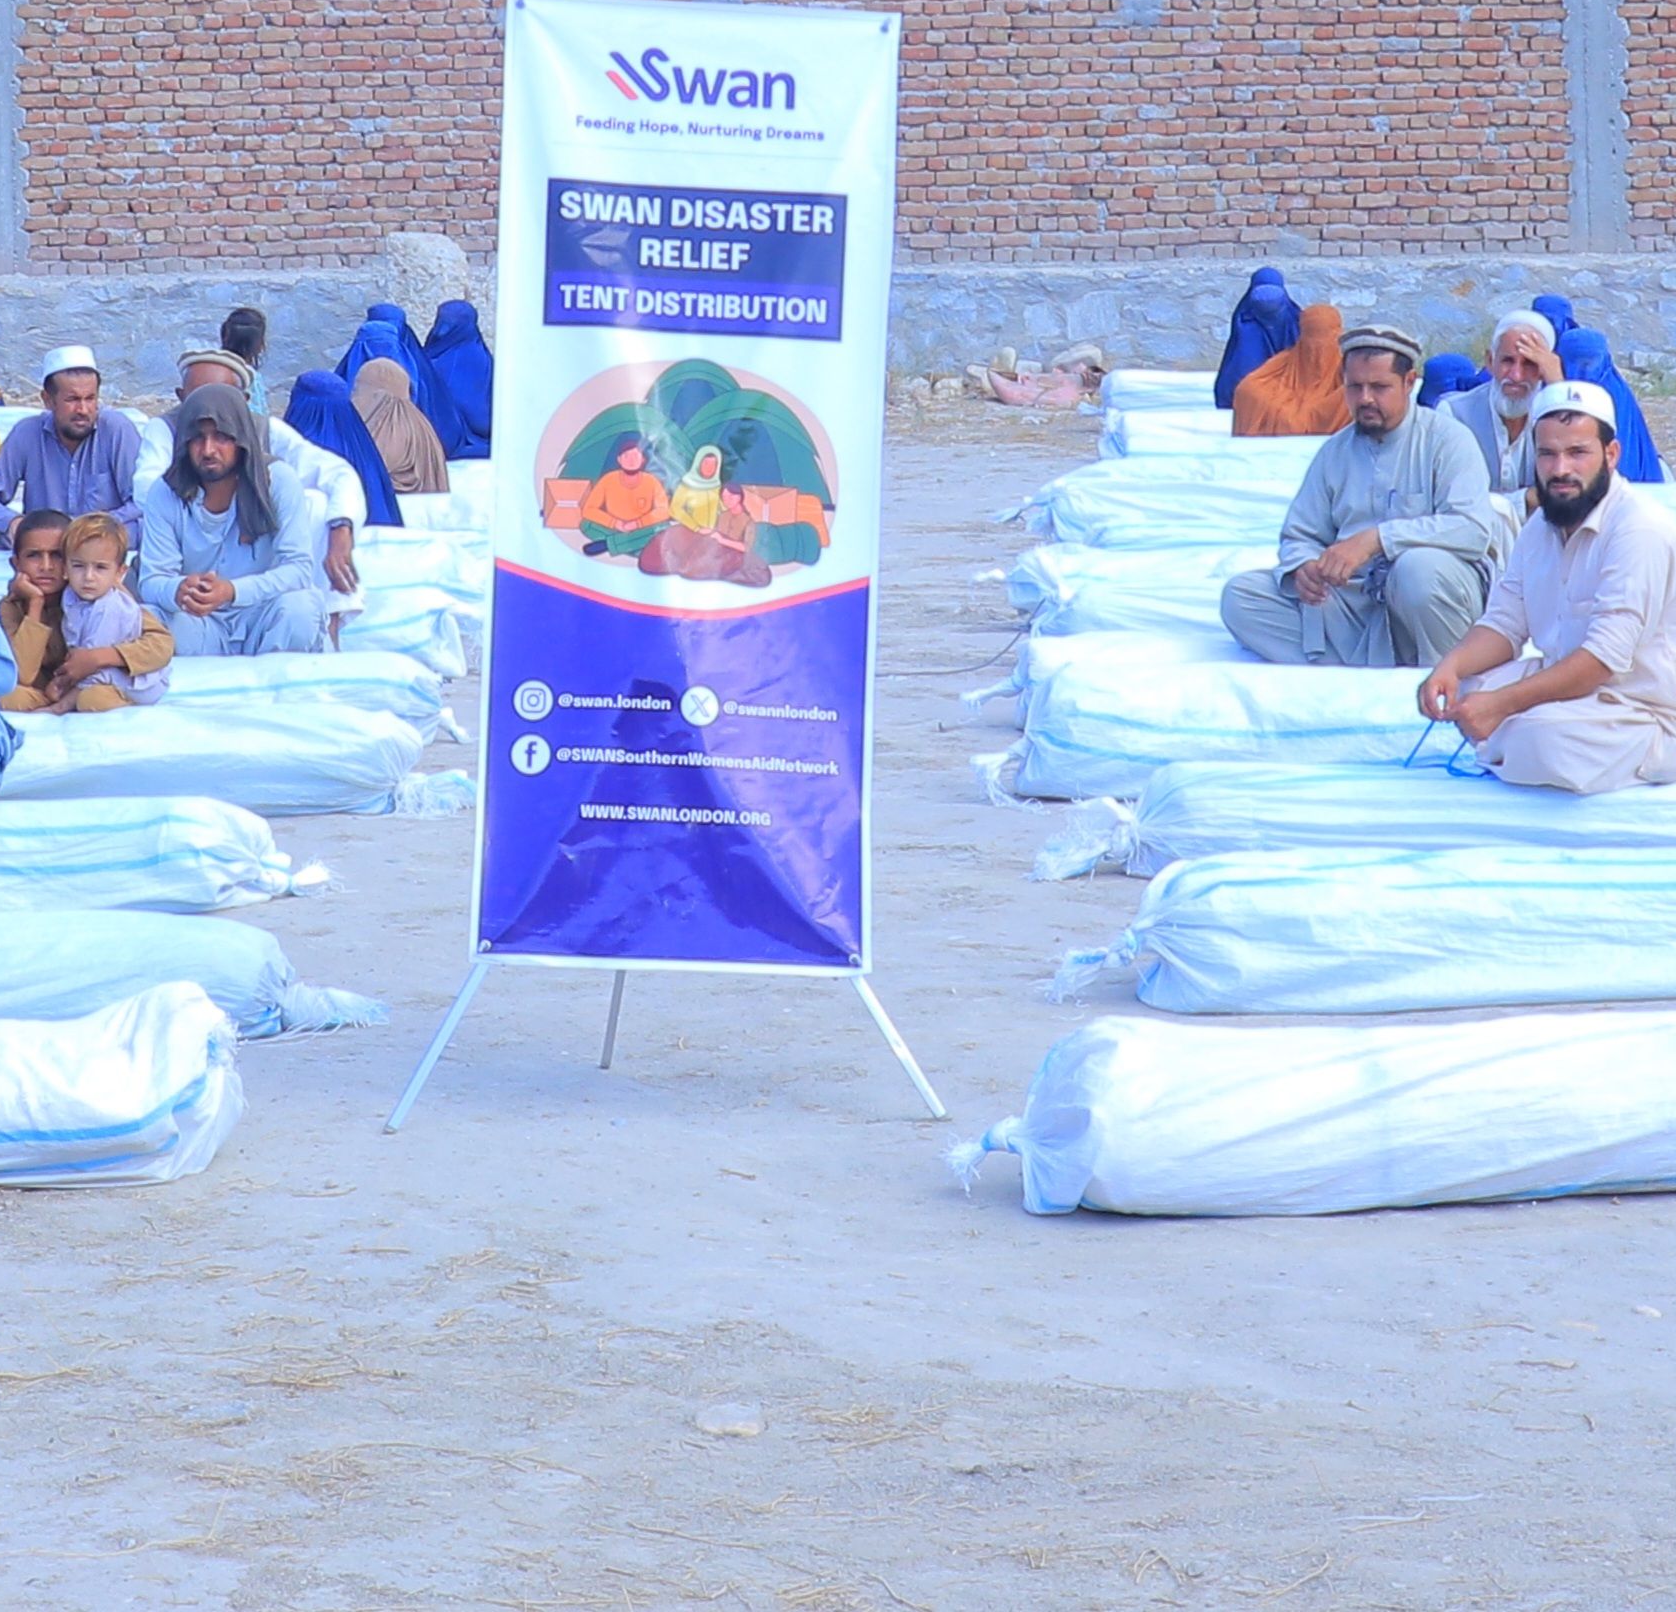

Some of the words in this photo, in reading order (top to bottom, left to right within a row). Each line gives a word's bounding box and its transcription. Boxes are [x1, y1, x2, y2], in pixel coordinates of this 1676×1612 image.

[609, 48, 796, 110] Swan
[576, 115, 636, 134] Feeding
[639, 119, 683, 137] Hope,
[687, 122, 762, 141] Nurturing
[766, 126, 825, 142] Dreams
[559, 191, 662, 226] SWAN
[670, 199, 835, 234] DISASTER
[639, 238, 751, 271] RELIEF
[559, 284, 630, 312] TENT
[636, 290, 828, 324] DISTRIBUTION
[558, 692, 672, 711] @swan.london
[724, 700, 838, 722] @swannlondon
[556, 746, 840, 776] @SWANSouthernWomensAidNetwork
[580, 804, 772, 826] WWW.SWANLONDON.ORG
